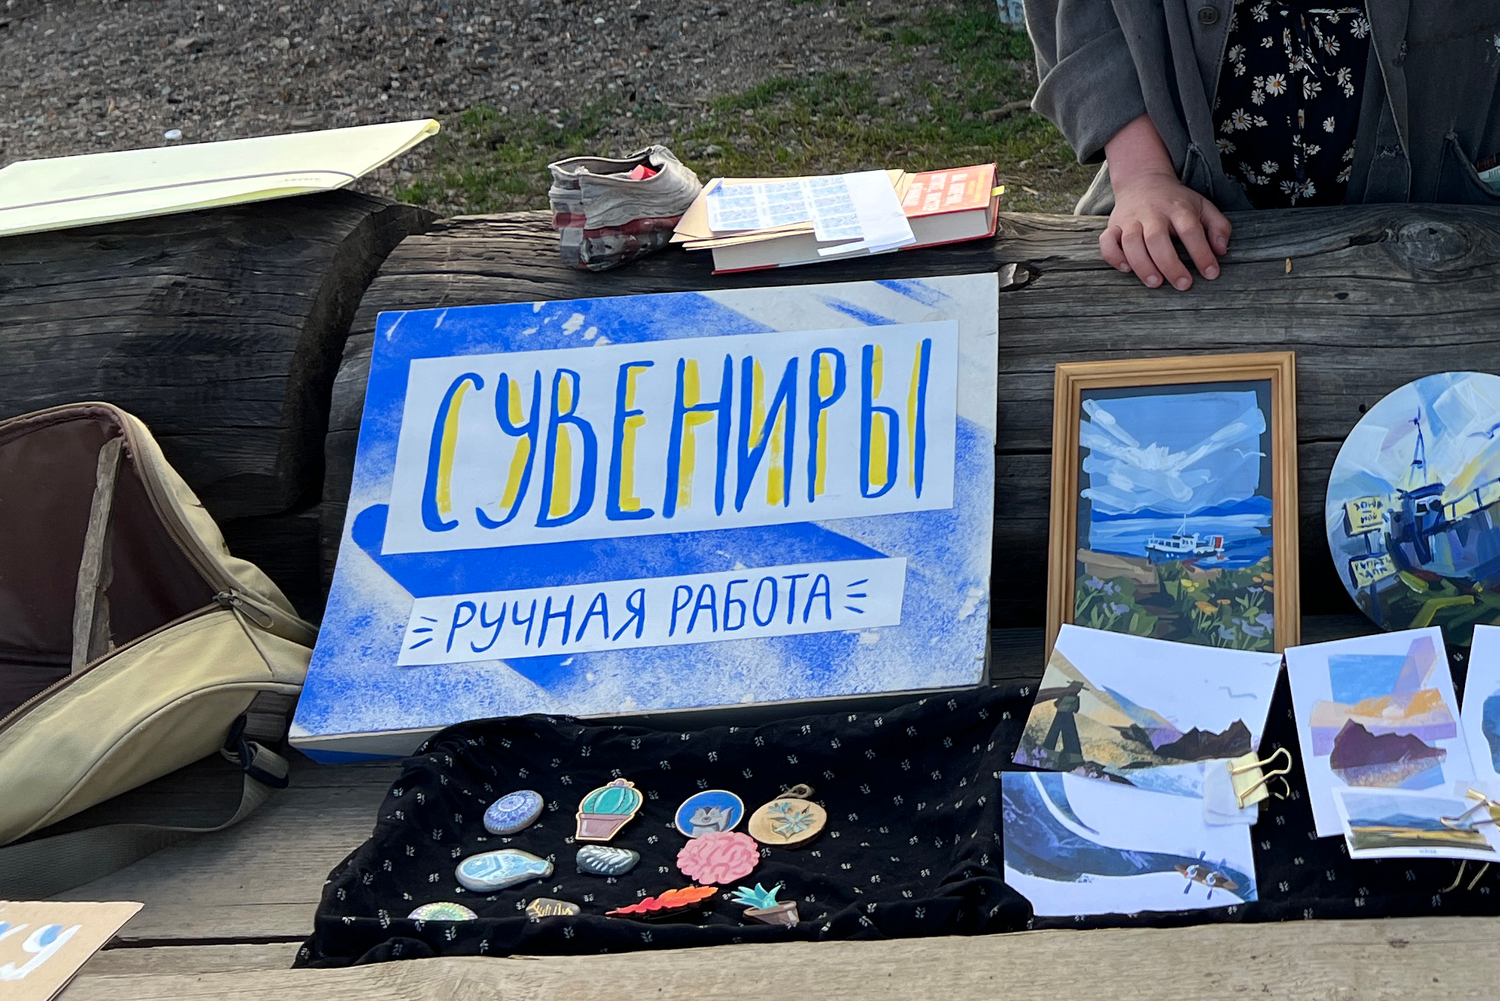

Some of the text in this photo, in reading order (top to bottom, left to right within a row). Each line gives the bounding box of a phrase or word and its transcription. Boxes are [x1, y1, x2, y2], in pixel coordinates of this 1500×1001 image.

[421, 337, 932, 533] СУВЕНИРЫ
[446, 573, 833, 653] РУЧНАЯ РАБОТА
